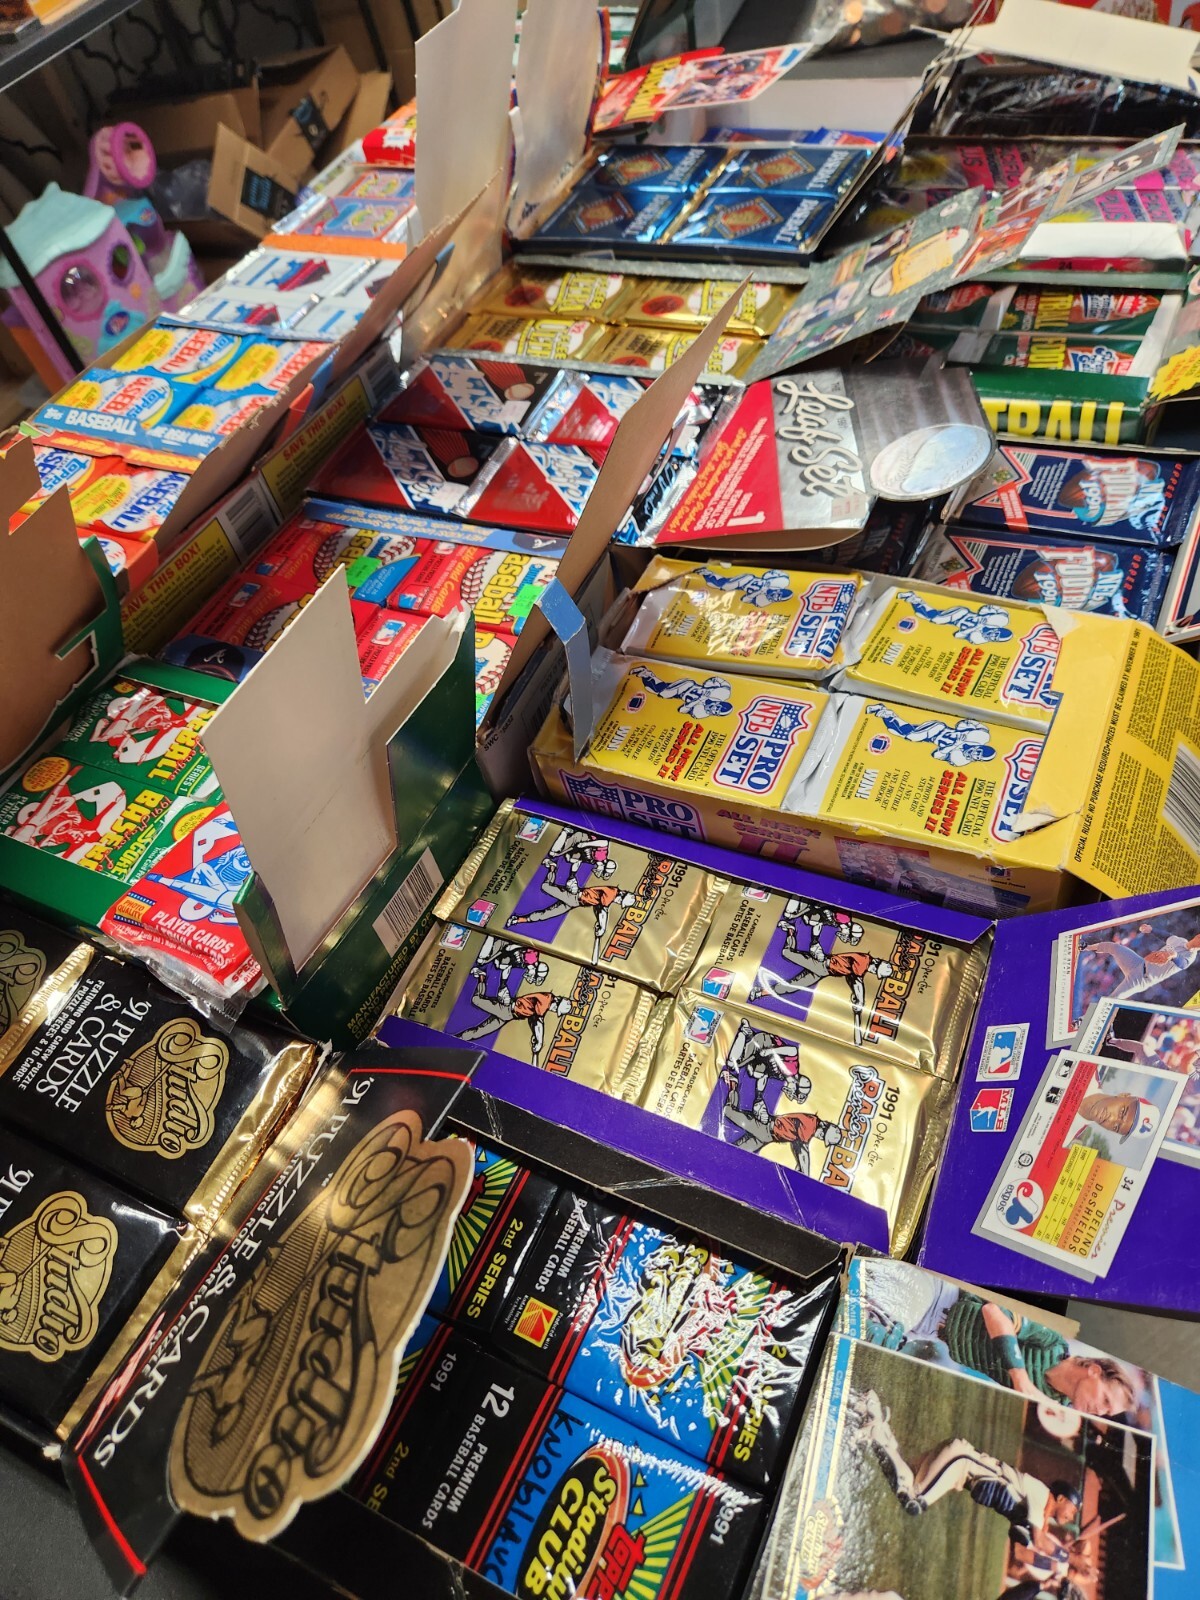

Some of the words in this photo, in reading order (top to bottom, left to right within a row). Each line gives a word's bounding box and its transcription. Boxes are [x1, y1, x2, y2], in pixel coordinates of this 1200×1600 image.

[1058, 260, 1073, 271] 24
[65, 410, 138, 436] BASEBALL
[283, 435, 307, 461] SAVE
[306, 414, 327, 440] THIS
[324, 395, 347, 421] BOX!
[776, 380, 855, 446] Leaf
[1164, 462, 1184, 500] UPPER
[726, 511, 766, 527] 1
[121, 592, 149, 623] SAVE
[147, 568, 176, 593] THIS
[174, 541, 201, 571] BOX!
[1122, 553, 1142, 592] UPPER
[430, 581, 454, 614] Cards
[793, 615, 823, 654] SET
[880, 641, 904, 666] WIN!
[949, 646, 973, 682] SERIES
[970, 648, 986, 667] ALL
[1126, 650, 1139, 674] NOVEMBER
[940, 680, 953, 695] II
[952, 667, 977, 697] NEW!
[973, 679, 990, 698] CARD
[1008, 655, 1046, 700] SET
[1117, 681, 1130, 703] CLAIMED
[1123, 673, 1131, 682] BY
[750, 702, 783, 733] NFL
[1109, 711, 1122, 727] MUST
[1115, 702, 1123, 711] BE
[665, 720, 694, 765] SERIES
[686, 723, 705, 746] ALL
[184, 764, 205, 788] SERIES
[668, 747, 694, 783] NEW!
[687, 760, 704, 781] CARD
[696, 748, 720, 783] OFFICIAL
[719, 735, 759, 785] SET
[747, 740, 788, 790] PRO
[855, 768, 880, 801] WIN!
[874, 771, 889, 803] PLAYBOOK
[890, 770, 911, 813] COLLECTIBLE
[930, 769, 955, 816] SERIES
[951, 771, 969, 796] ALL
[976, 778, 987, 794] 1990
[987, 780, 997, 798] THE
[1089, 773, 1104, 805] PURCHASE
[620, 789, 696, 823] PRO
[909, 790, 922, 813] CARDS
[970, 794, 981, 811] NFL
[1087, 804, 1096, 814] NO
[716, 808, 755, 825] ALL
[759, 815, 822, 840] NEW!
[733, 820, 809, 846] SERIES
[923, 815, 939, 834] II
[938, 798, 960, 838] NEW!
[961, 811, 976, 837] CARD
[970, 798, 991, 839] OFFICIAL
[1081, 814, 1095, 835] RULES:
[111, 827, 157, 878] SCORE
[506, 847, 526, 877] BASEBALL
[1073, 834, 1089, 864] OFFICIAL
[484, 868, 503, 900] BASEBALL
[673, 863, 689, 889] 1991
[117, 904, 143, 920] QUALITY
[121, 899, 146, 912] PHOTO
[601, 859, 677, 963] BASEBALL
[736, 899, 749, 923] CARTES
[151, 910, 195, 936] PLAYER
[192, 929, 235, 955] CARDS
[739, 906, 756, 938] BASEBALL
[432, 947, 447, 973] CARTES
[715, 931, 734, 966] BASEBALL
[727, 937, 742, 962] CARDS
[231, 955, 256, 984] SPEC
[346, 945, 409, 1031] MANUFACTURED
[408, 930, 421, 946] BY
[433, 955, 452, 989] BASEBALL
[65, 985, 89, 1013] PUZZLE
[74, 979, 106, 1019] FEATURING
[93, 993, 122, 1012] &
[120, 996, 153, 1022] '91
[408, 982, 430, 1019] BASEBALL
[419, 988, 435, 1014] CARDS
[1101, 1002, 1113, 1026] KELLY
[44, 1011, 70, 1039] PIECES
[62, 1016, 77, 1035] ROD
[351, 996, 381, 1036] GRAND
[30, 1045, 43, 1055] 10
[35, 1016, 105, 1098] CARDS
[41, 1035, 63, 1062] CAREW
[676, 1042, 691, 1069] CARTES
[12, 1056, 35, 1083] CARDS
[18, 1061, 43, 1091] PUZZLE
[54, 1019, 136, 1113] PUZZLE
[155, 1020, 224, 1153] Studio
[878, 1086, 901, 1122] 1991
[994, 1089, 1011, 1131] MLB
[234, 1112, 351, 1261] PUZZLE
[997, 1184, 1015, 1211] expos
[1121, 1176, 1134, 1192] 34
[231, 1217, 256, 1250] ROD
[499, 1218, 524, 1249] 2nd
[554, 1197, 588, 1251] BASEBALL
[1068, 1183, 1104, 1253] DeSHIELDS
[1078, 1210, 1104, 1257] DELINO
[1091, 1197, 1126, 1259] Premier
[35, 1205, 110, 1356] Studio
[189, 1254, 230, 1311] CAREW
[205, 1264, 237, 1298] &
[466, 1251, 508, 1320] SERIES
[535, 1254, 560, 1293] CARDS
[242, 1120, 456, 1521] Studio
[548, 1311, 563, 1337] Produced
[542, 1336, 552, 1350] with
[93, 1304, 211, 1468] CARDS
[430, 1352, 457, 1392] 1991
[832, 1368, 844, 1401] CARL
[480, 1382, 515, 1418] 12
[384, 1440, 410, 1480] 2nd
[445, 1412, 487, 1479] BASEBALL
[446, 1442, 489, 1513] PREMIUM
[422, 1482, 451, 1530] CARDS
[524, 1476, 585, 1596] CLUB
